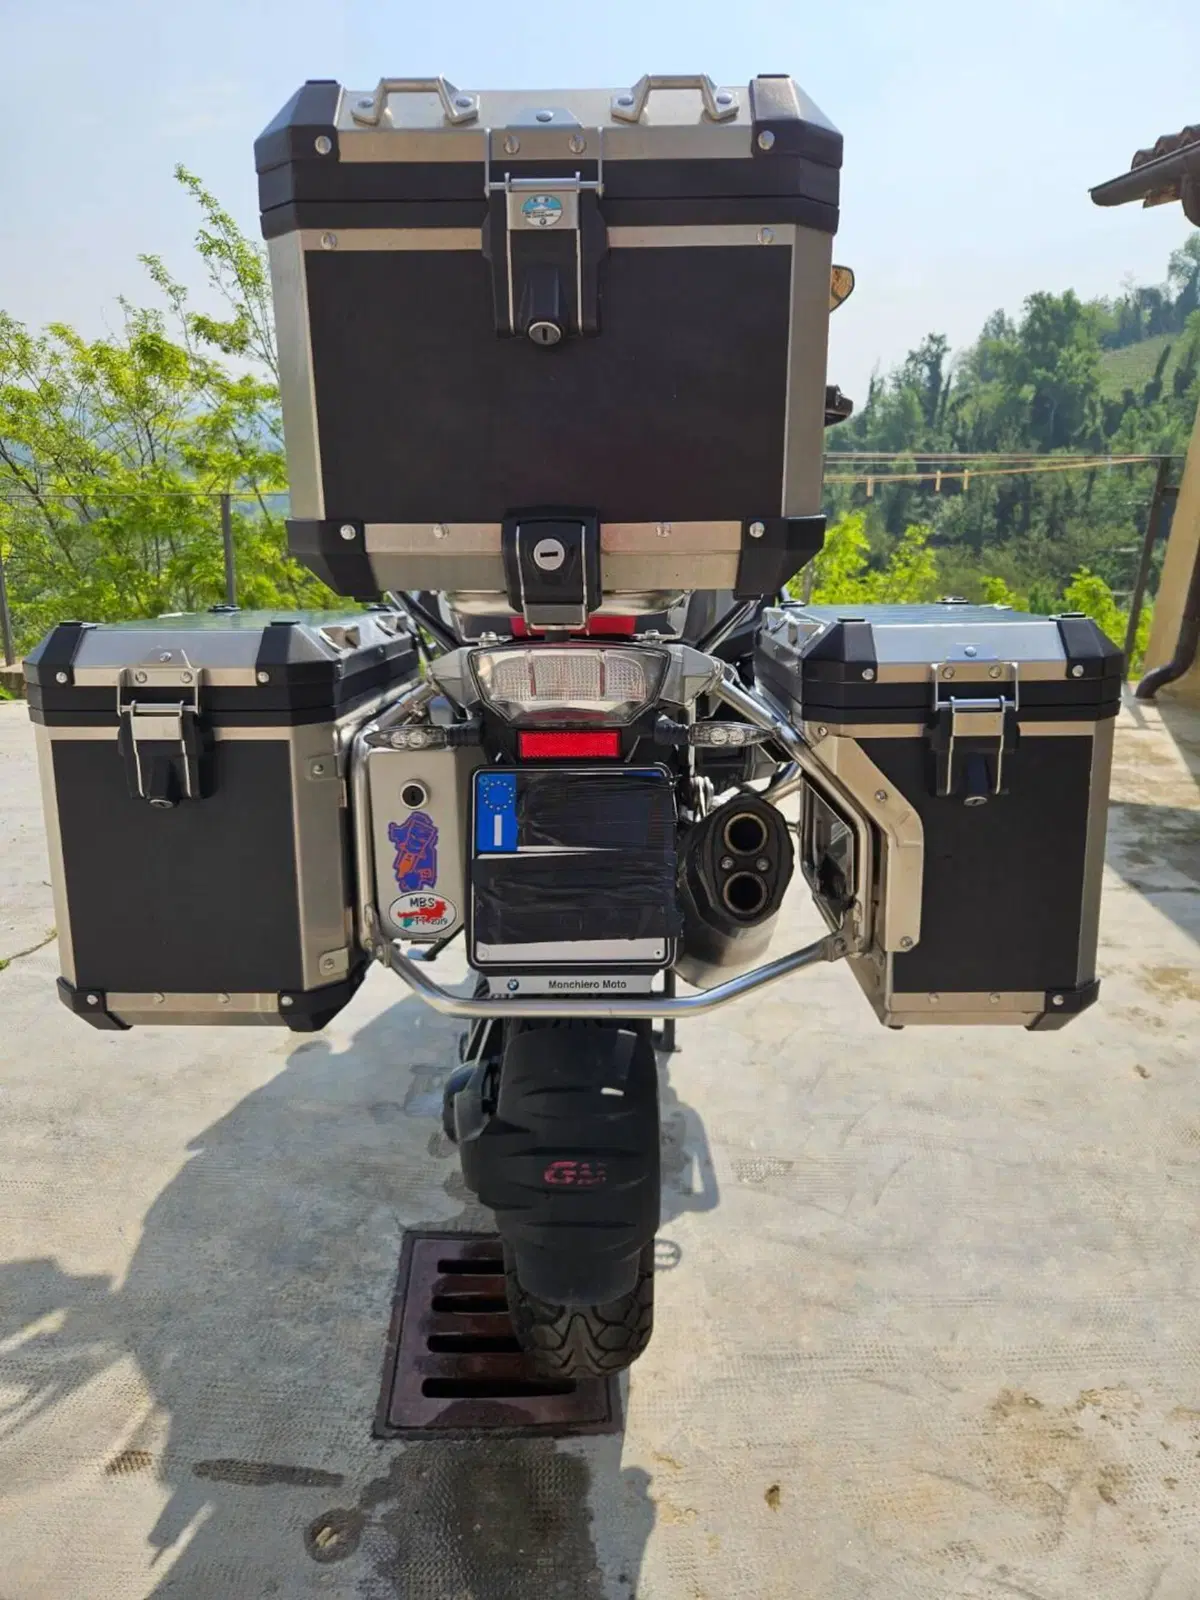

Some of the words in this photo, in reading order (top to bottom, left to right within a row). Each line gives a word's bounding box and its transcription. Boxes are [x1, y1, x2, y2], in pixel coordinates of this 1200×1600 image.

[494, 815, 502, 846] I
[409, 897, 435, 908] MBS
[549, 980, 600, 989] Monchiero
[603, 980, 627, 989] Moto
